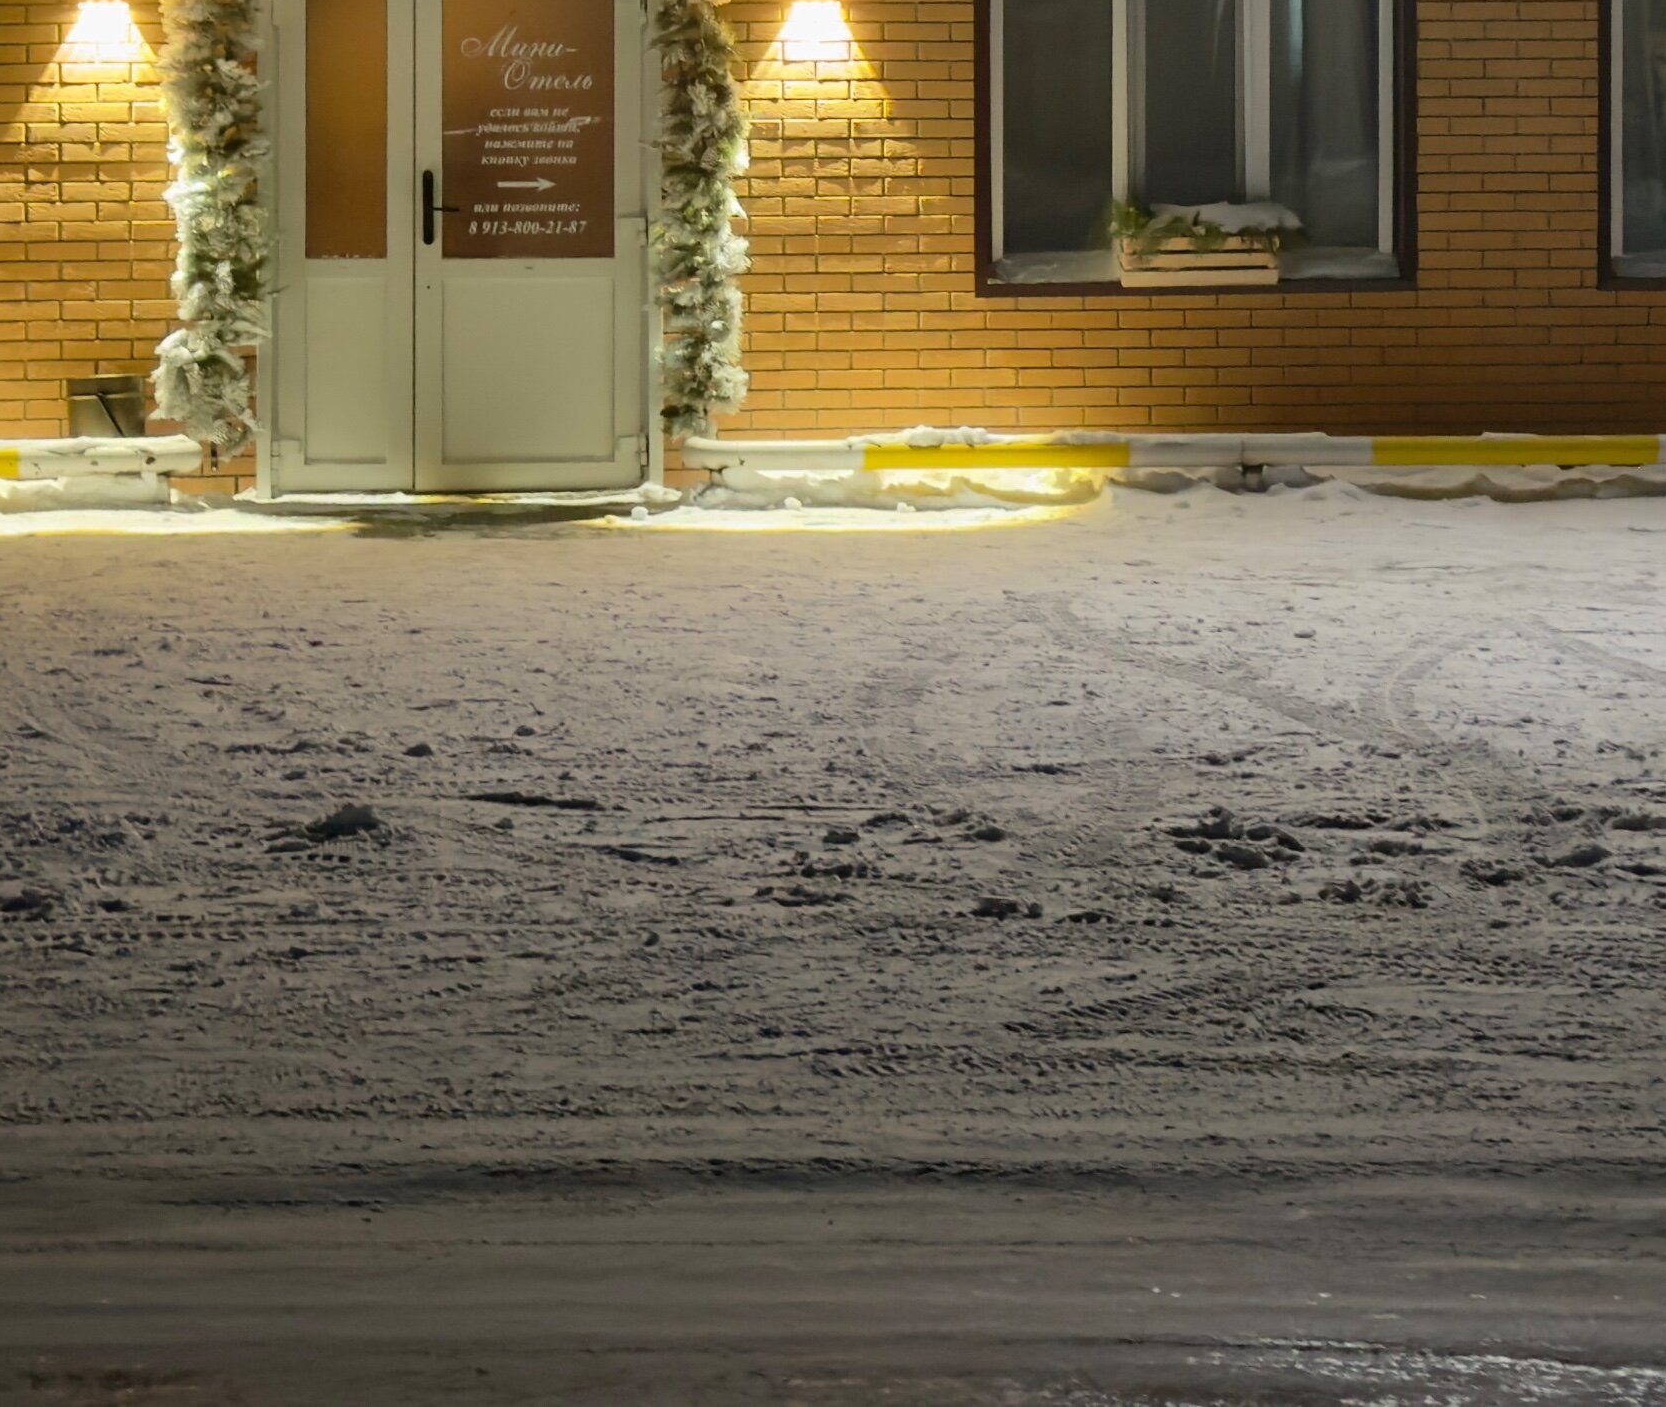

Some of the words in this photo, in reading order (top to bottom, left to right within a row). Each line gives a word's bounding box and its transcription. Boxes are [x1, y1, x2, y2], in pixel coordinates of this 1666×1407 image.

[460, 25, 578, 59] Мини-
[501, 57, 593, 91] Отель
[489, 107, 521, 118] если
[523, 108, 549, 118] вам
[552, 107, 569, 118] не
[484, 139, 554, 149] нажмите
[557, 139, 574, 149] на
[481, 155, 530, 167] кнопку
[473, 202, 499, 213] или
[503, 201, 581, 213] позвоните:
[468, 220, 479, 235] 8
